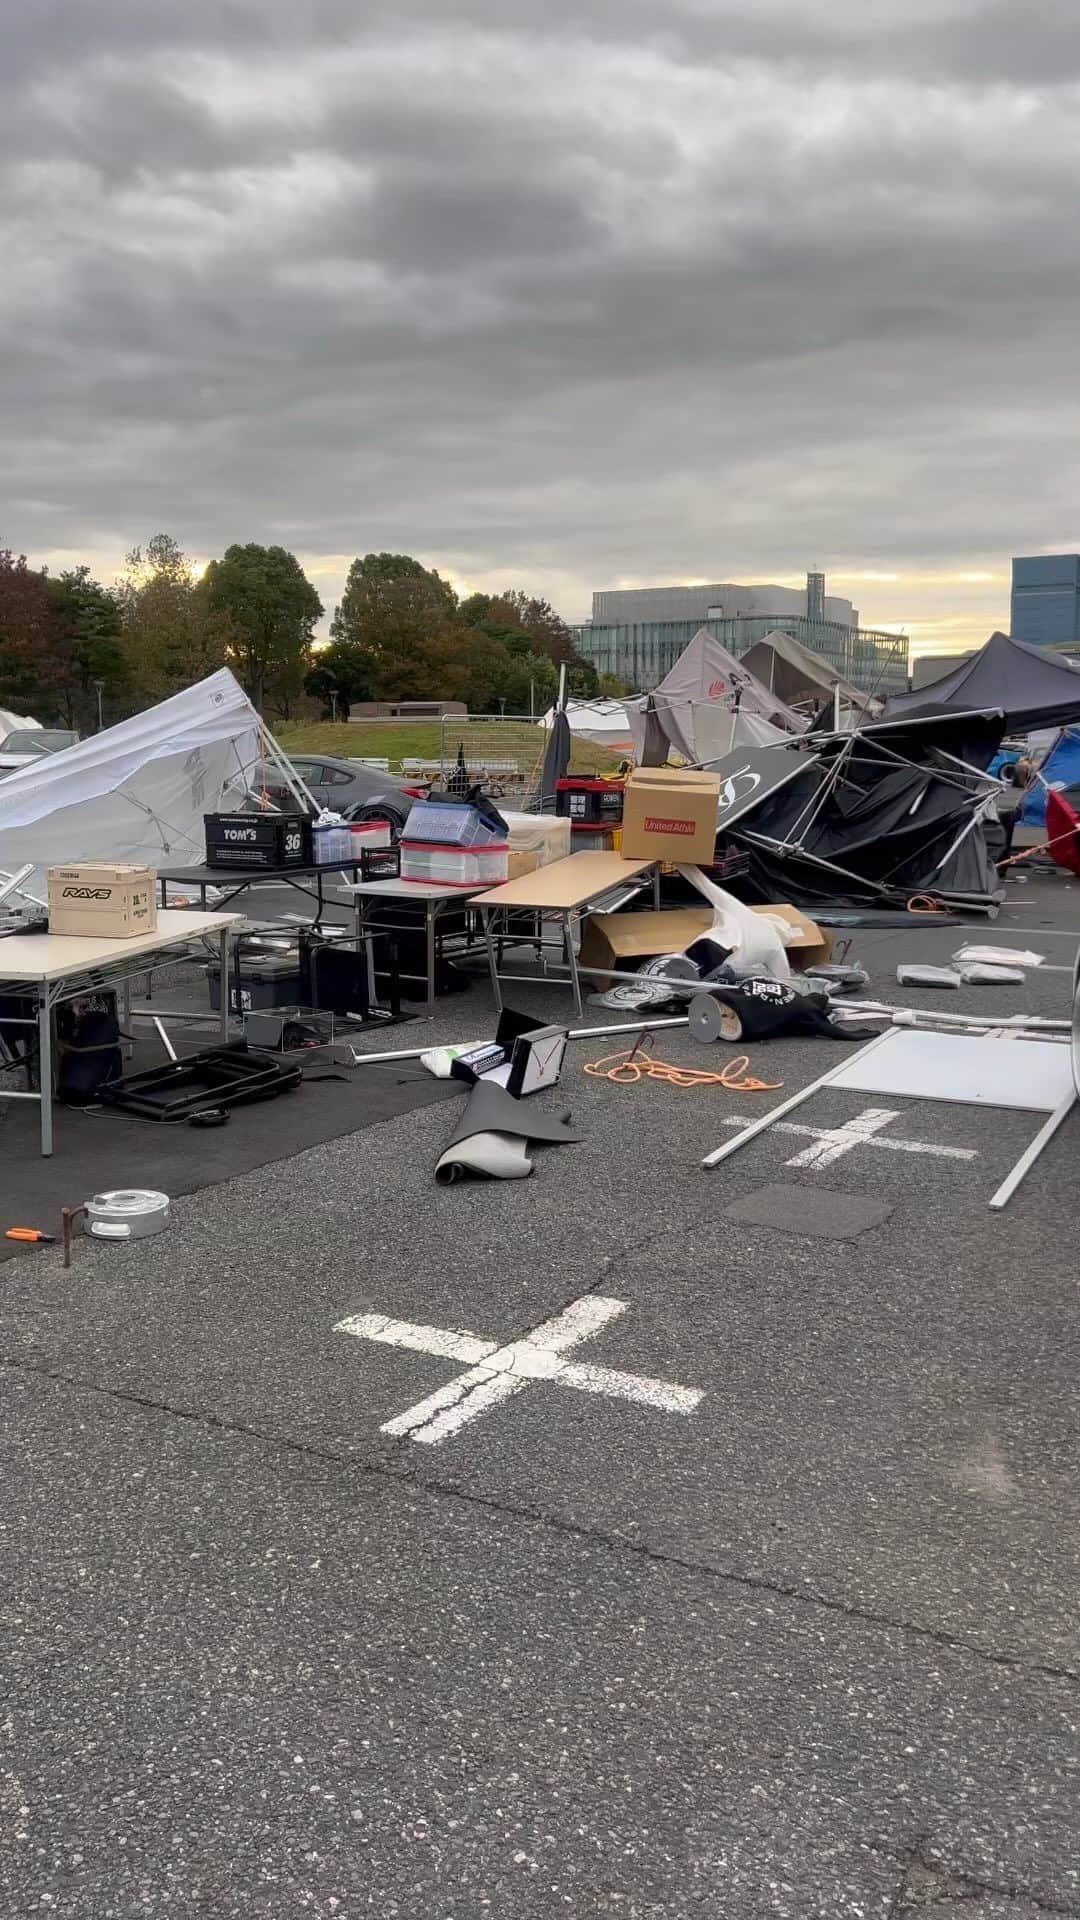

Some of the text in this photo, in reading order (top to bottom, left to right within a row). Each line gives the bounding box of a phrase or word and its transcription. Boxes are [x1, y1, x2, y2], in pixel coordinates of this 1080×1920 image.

[224, 828, 257, 841] TOM'S
[285, 833, 301, 850] 36
[62, 887, 112, 899] RAYS
